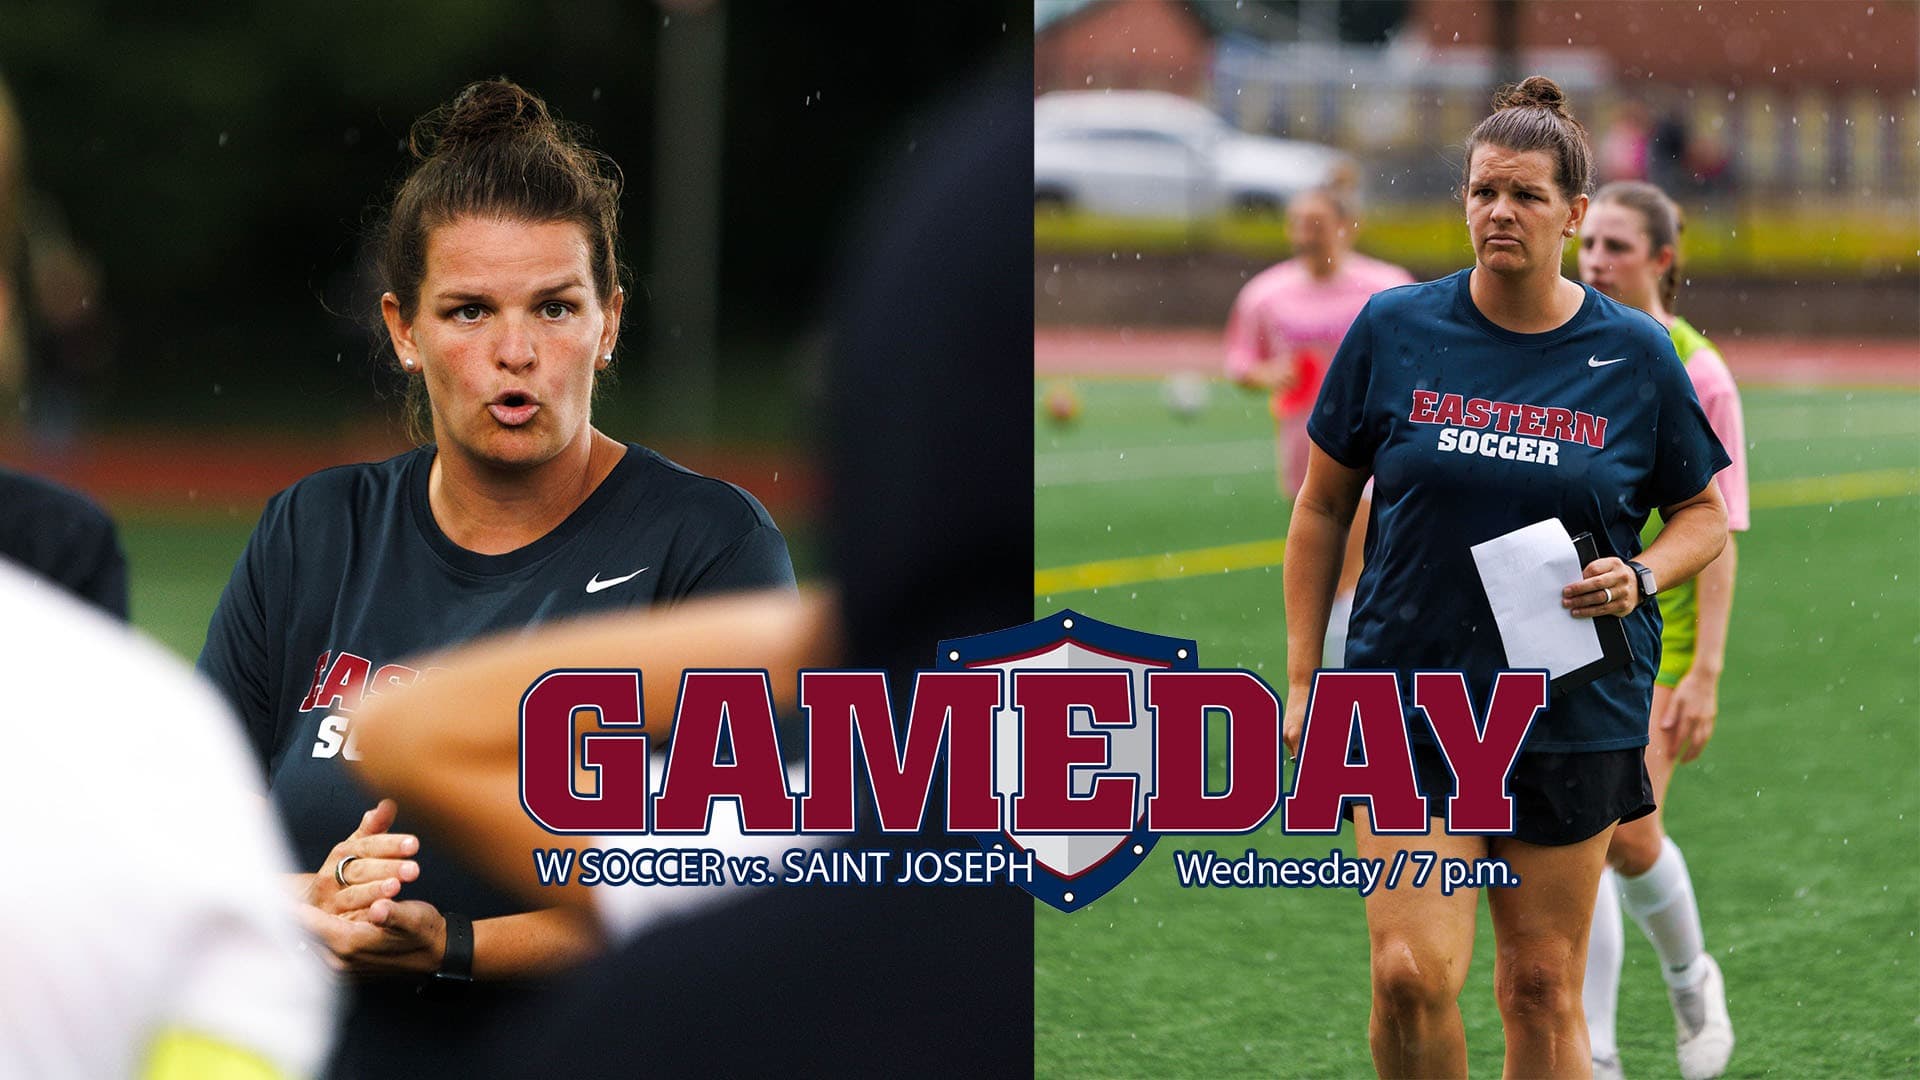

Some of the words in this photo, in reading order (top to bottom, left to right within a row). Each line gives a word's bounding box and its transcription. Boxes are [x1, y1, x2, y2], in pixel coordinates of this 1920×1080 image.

[1409, 389, 1608, 449] EASTERN
[1437, 428, 1559, 466] SOCCER
[298, 650, 446, 712] EAS
